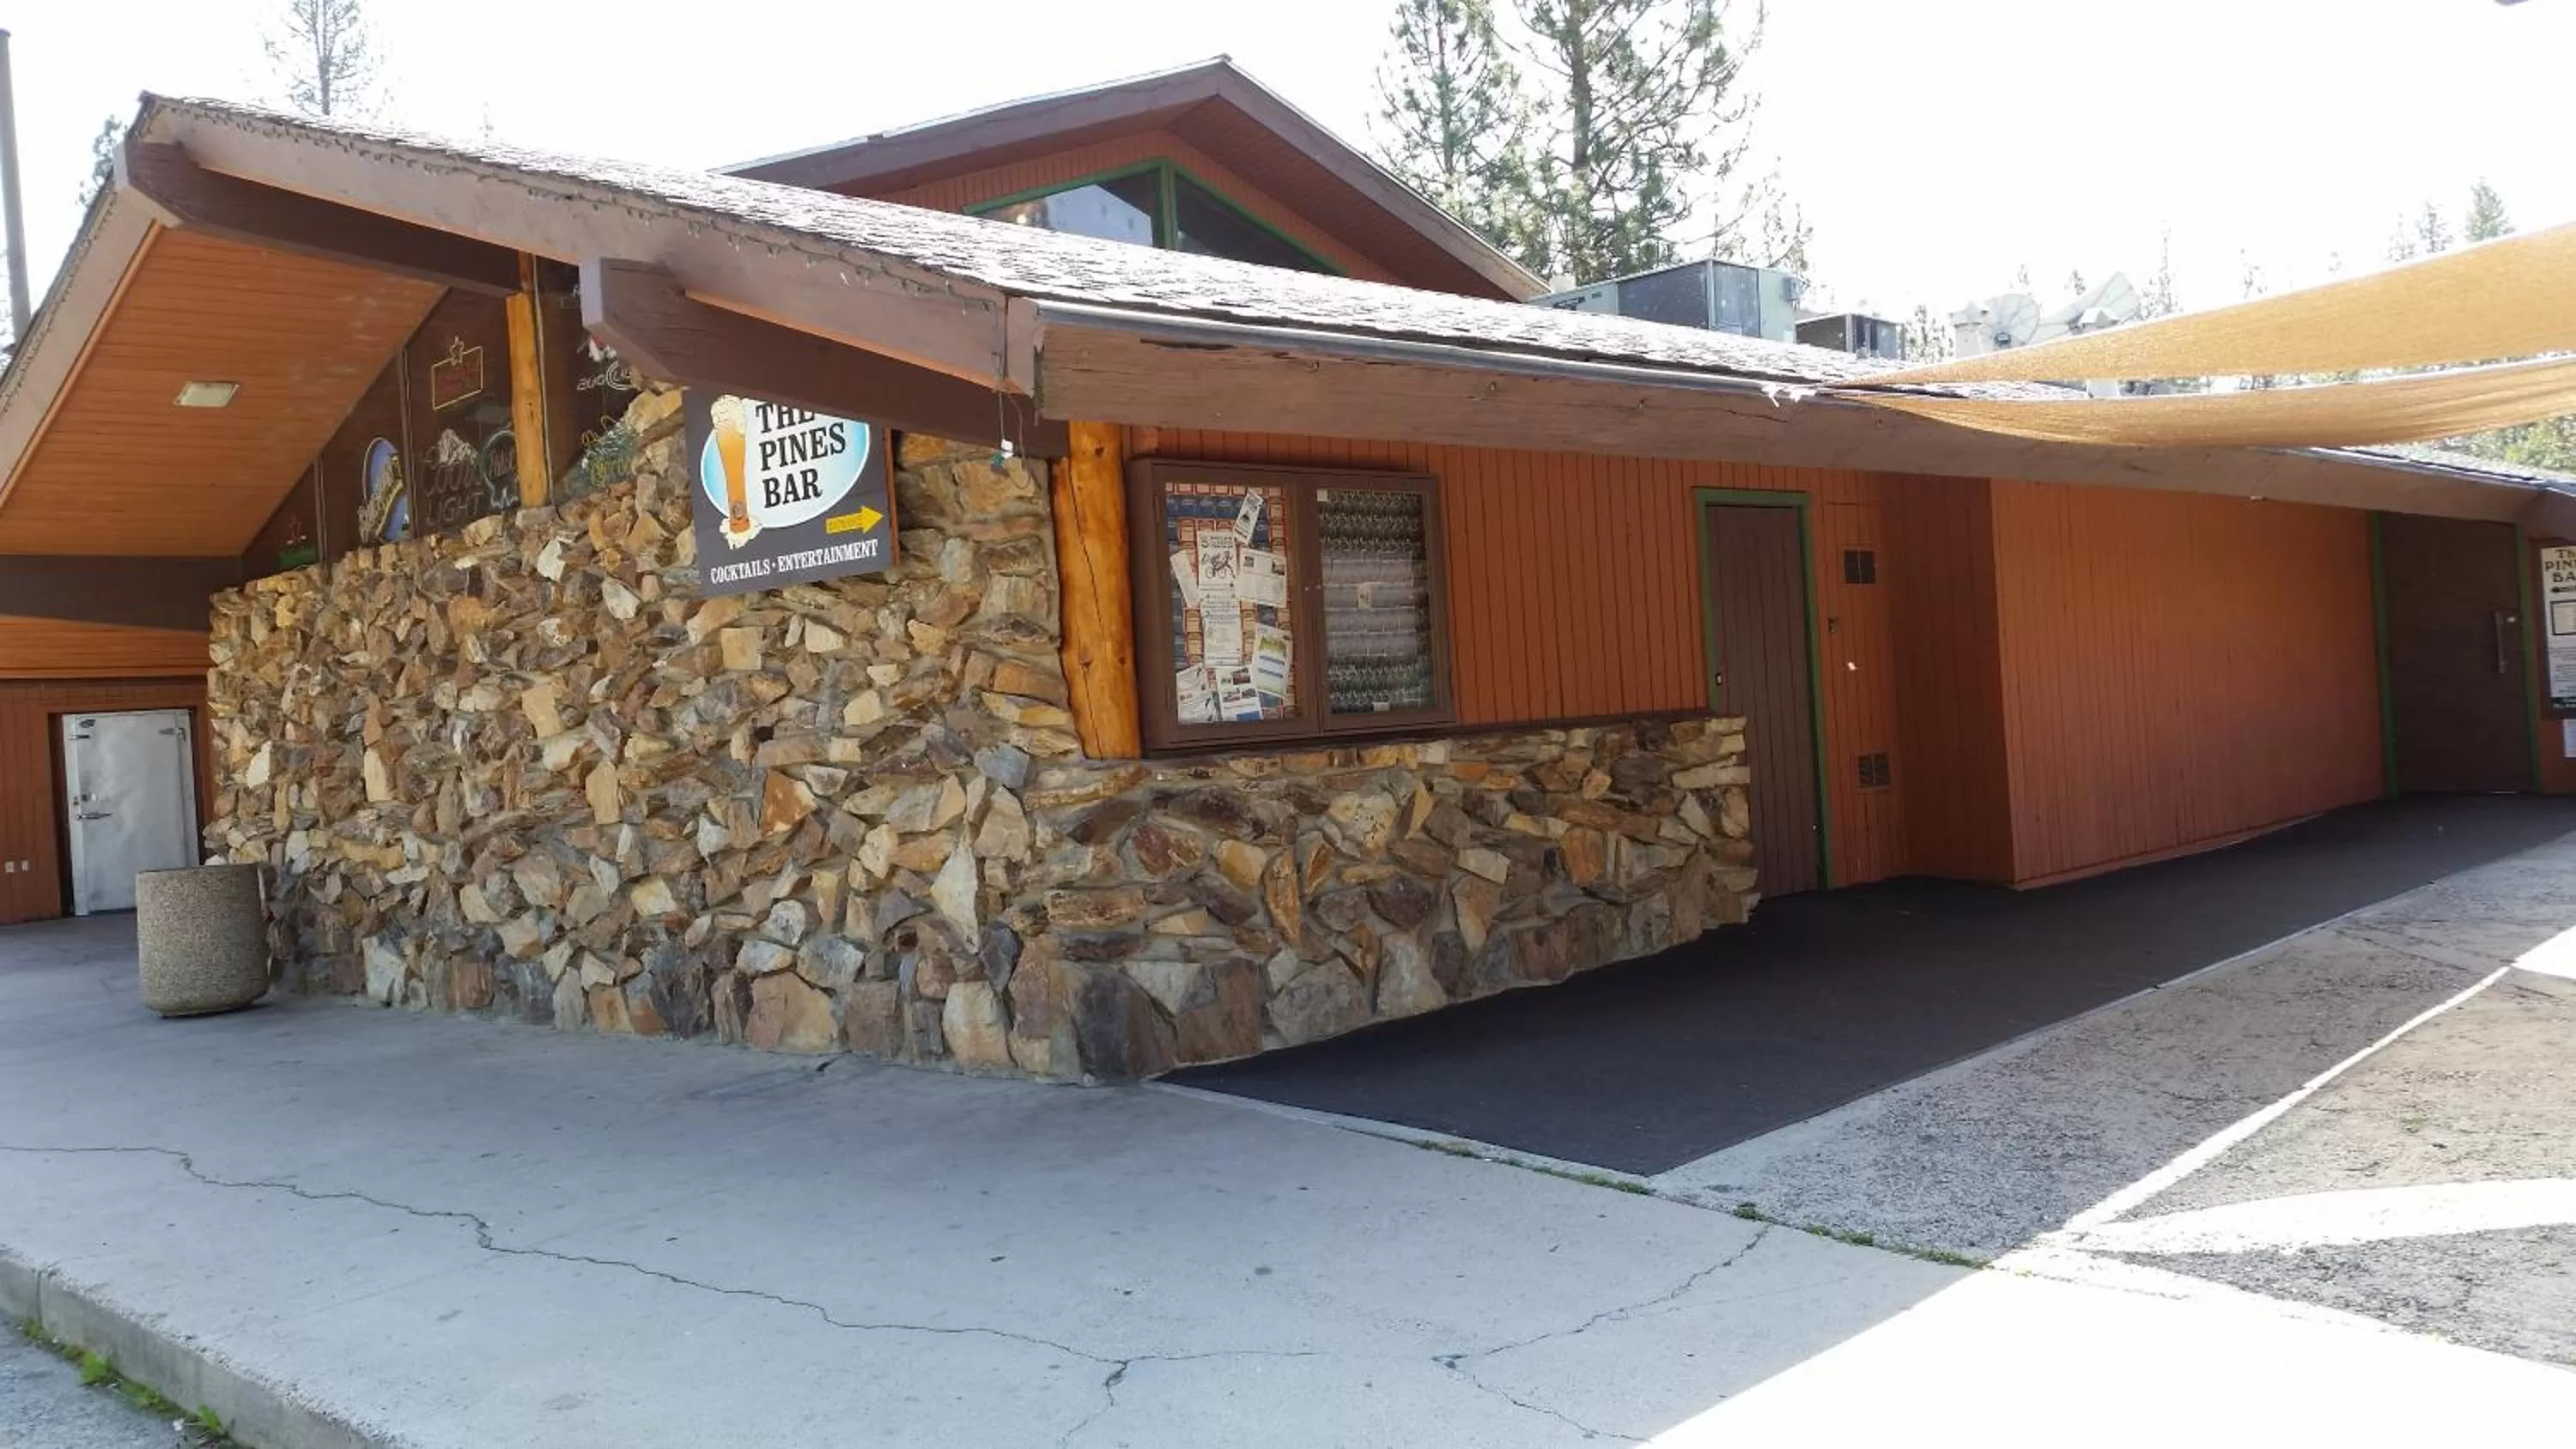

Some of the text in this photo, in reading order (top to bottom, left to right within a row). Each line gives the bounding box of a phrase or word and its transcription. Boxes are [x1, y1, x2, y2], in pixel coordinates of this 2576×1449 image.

[759, 421, 846, 471] PINES
[762, 468, 823, 508] BAR
[710, 539, 878, 584] COCKTAILS ENTERTAINMENT
[2545, 560, 2576, 572] PIN
